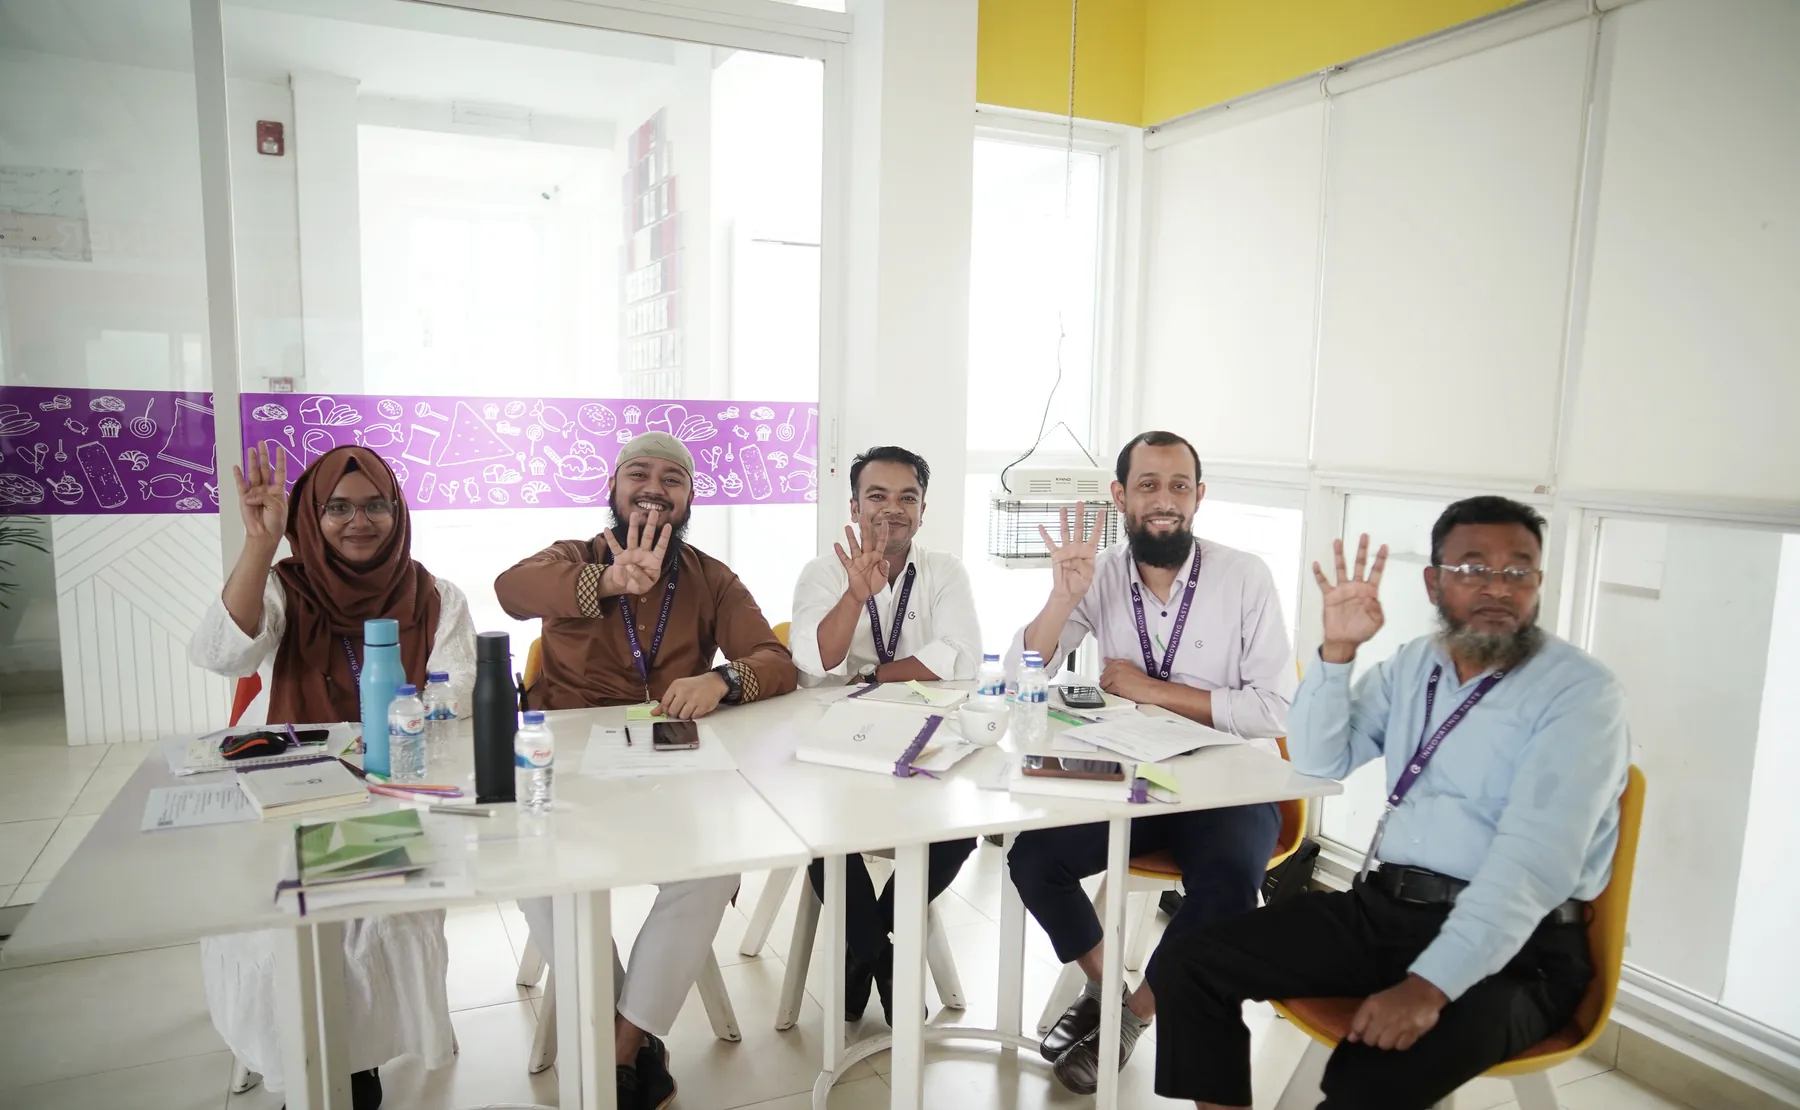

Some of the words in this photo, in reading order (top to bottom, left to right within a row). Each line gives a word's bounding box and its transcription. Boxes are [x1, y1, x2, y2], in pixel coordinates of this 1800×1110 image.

[622, 605, 636, 646] INNOVATING
[657, 594, 671, 633] INNOVATING
[891, 607, 904, 645] INNOVATING
[900, 588, 909, 606] TASTE
[1136, 607, 1149, 649] INNOVATING
[1145, 650, 1154, 671] TASTE
[1165, 624, 1183, 666] INNOVATING
[1178, 602, 1189, 623] TASTE
[652, 635, 660, 654] TASTE
[1421, 714, 1460, 759] INNOVATING
[1460, 692, 1481, 712] TASTE
